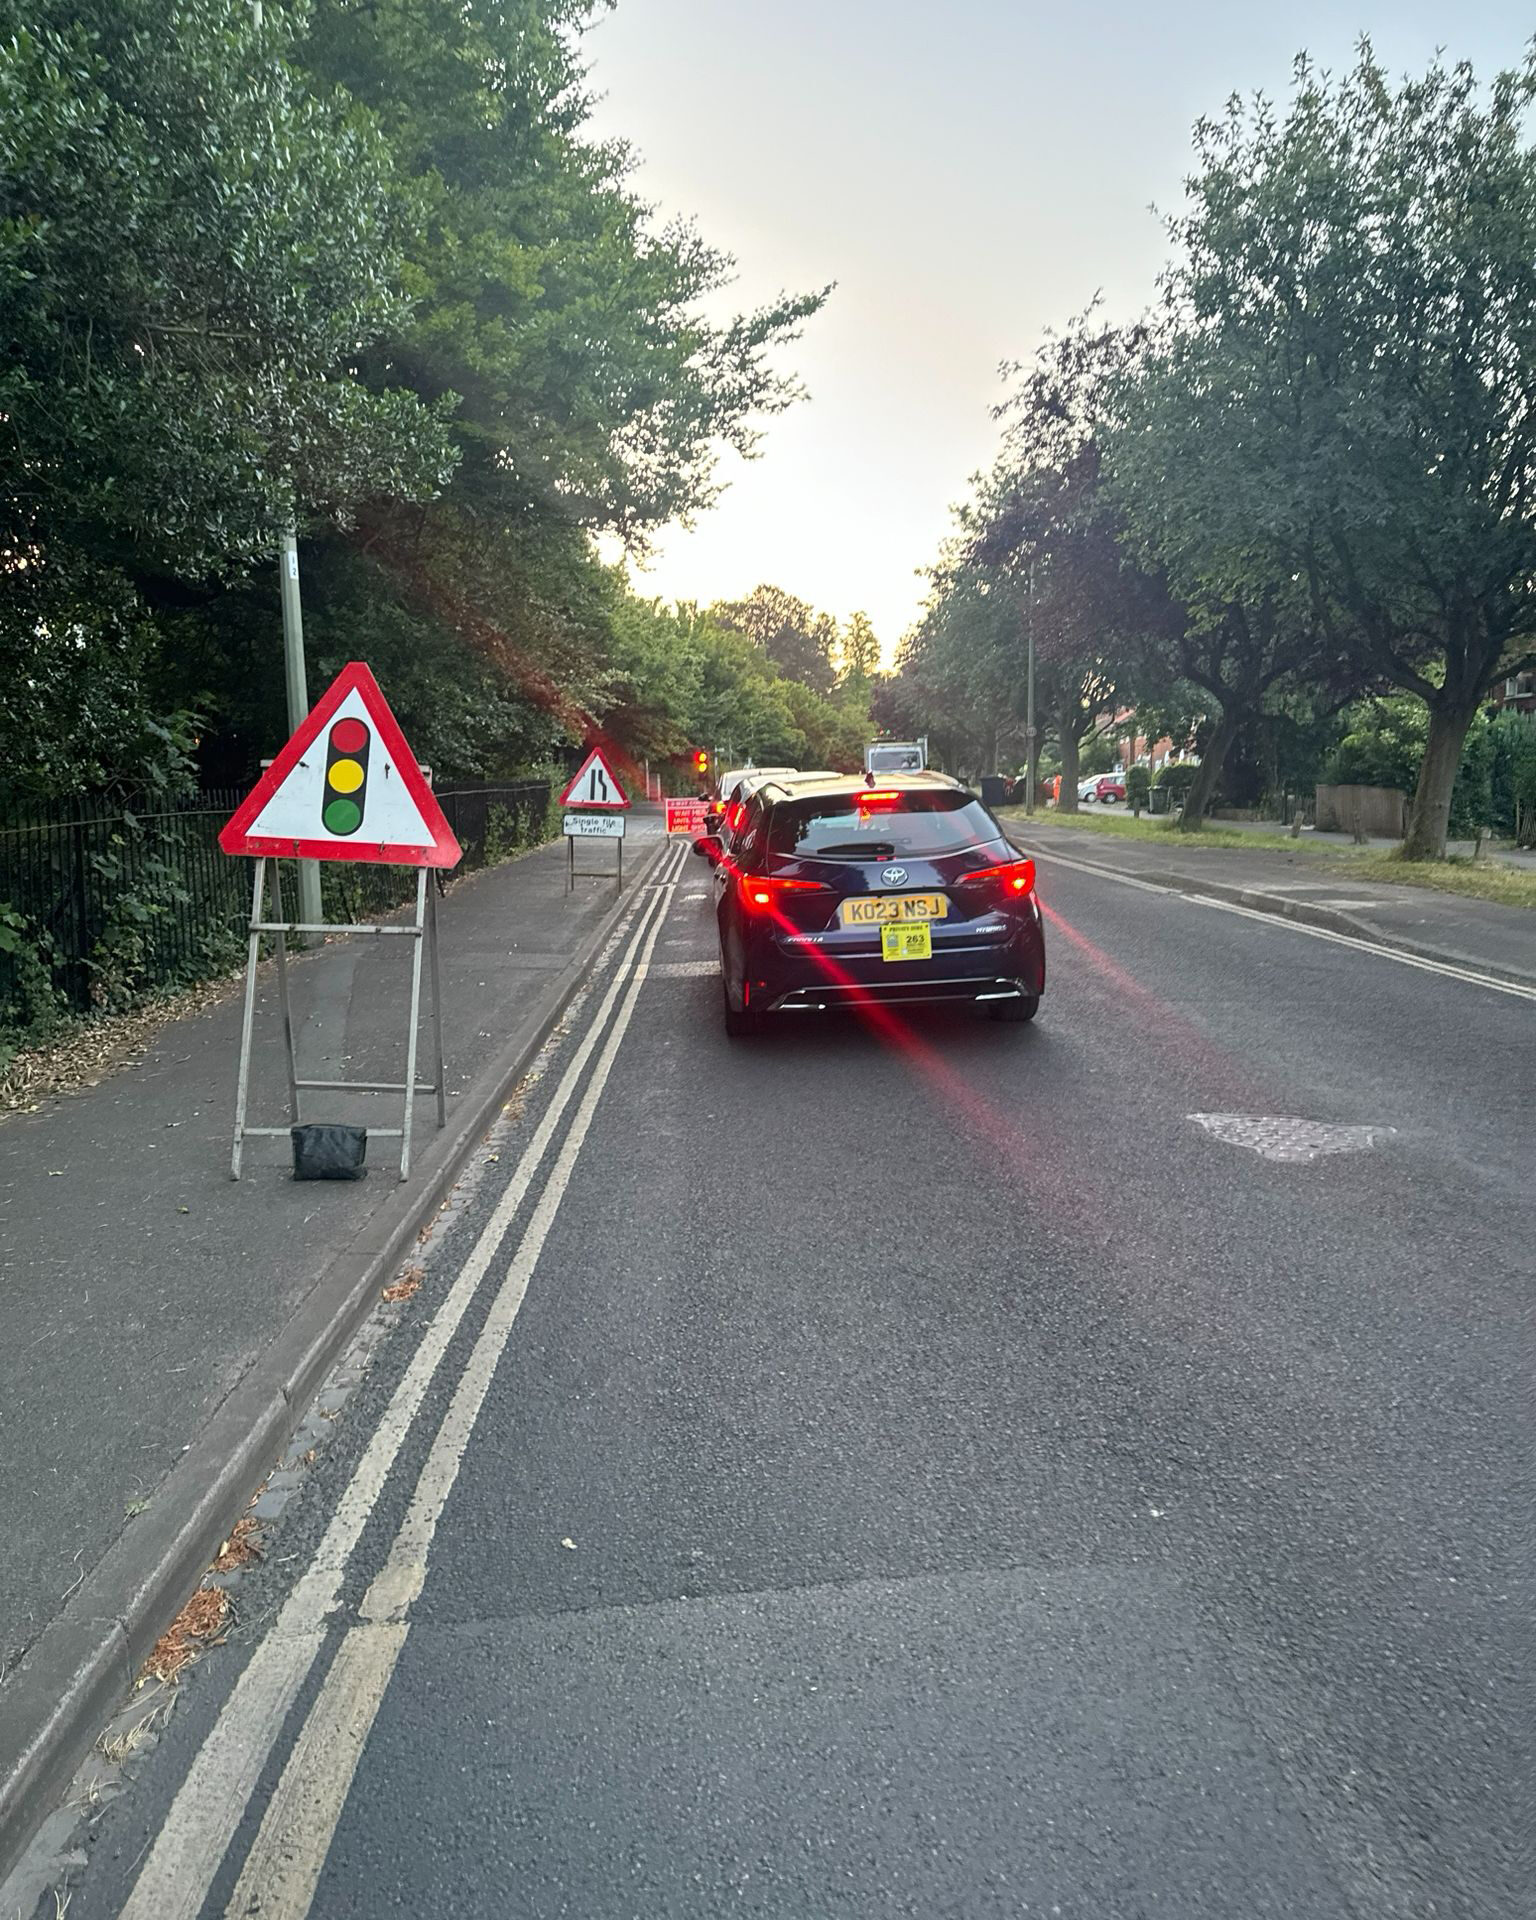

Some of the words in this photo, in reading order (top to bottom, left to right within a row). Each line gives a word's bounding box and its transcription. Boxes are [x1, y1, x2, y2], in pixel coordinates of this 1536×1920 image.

[573, 817, 600, 826] Single
[851, 901, 900, 921] KO23
[903, 898, 940, 918] NSJ
[905, 934, 925, 944] 263
